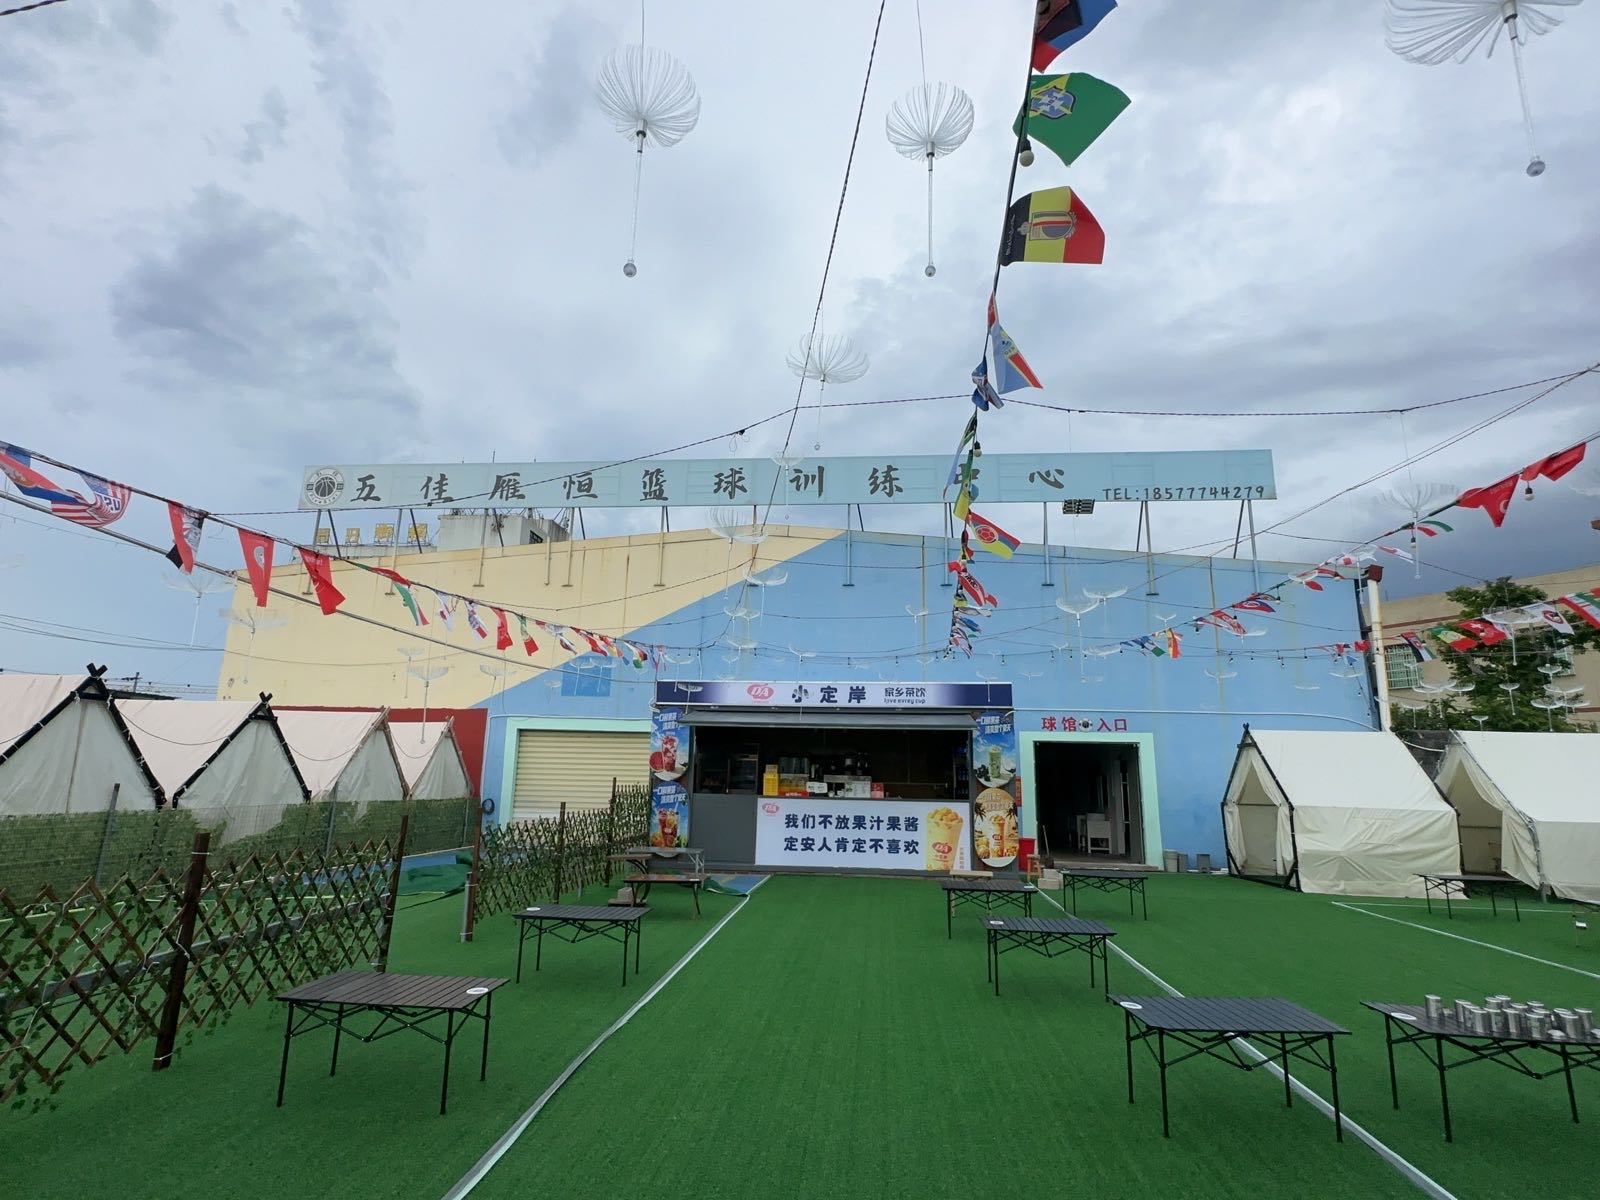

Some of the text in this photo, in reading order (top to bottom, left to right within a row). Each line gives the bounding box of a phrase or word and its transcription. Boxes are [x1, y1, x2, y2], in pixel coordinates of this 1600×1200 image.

[1102, 486, 1264, 500] TEL:18577744279
[792, 685, 866, 703] 小定岸
[884, 687, 926, 697] 家乡茶饮
[1041, 716, 1128, 732] 球馆 入口
[784, 813, 919, 832] 我们不放果汁果酱
[784, 836, 919, 855] 定安人肯定不喜欢
